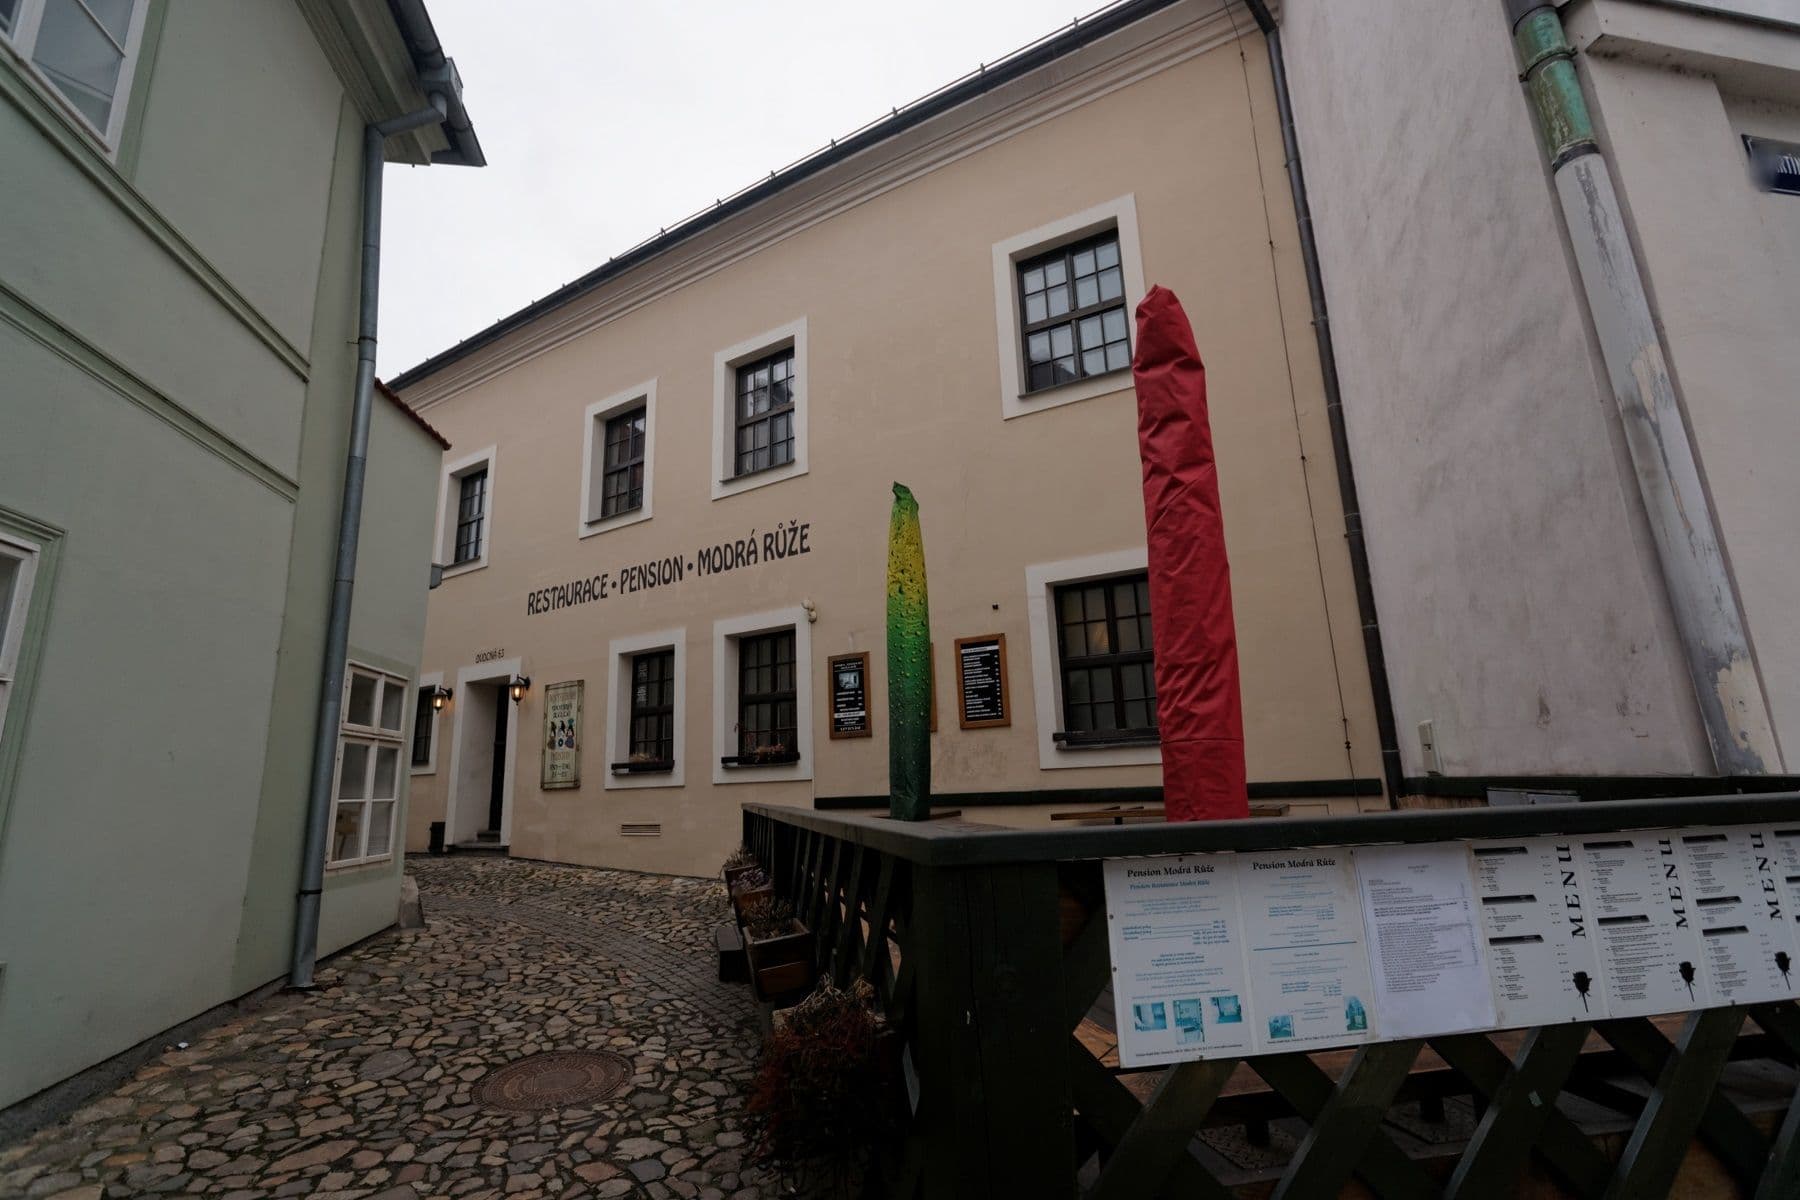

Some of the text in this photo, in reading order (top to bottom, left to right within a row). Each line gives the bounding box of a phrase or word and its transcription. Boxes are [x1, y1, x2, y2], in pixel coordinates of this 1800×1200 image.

[527, 519, 811, 616] RESTAURACE PENSION MODRÁ RŮŽE
[1127, 863, 1216, 878] Pension Modrá Růže
[1253, 857, 1337, 871] Pension Modrá Růže
[1555, 843, 1586, 939] MENU
[1658, 836, 1689, 931] MENU
[1750, 831, 1783, 921] MENU
